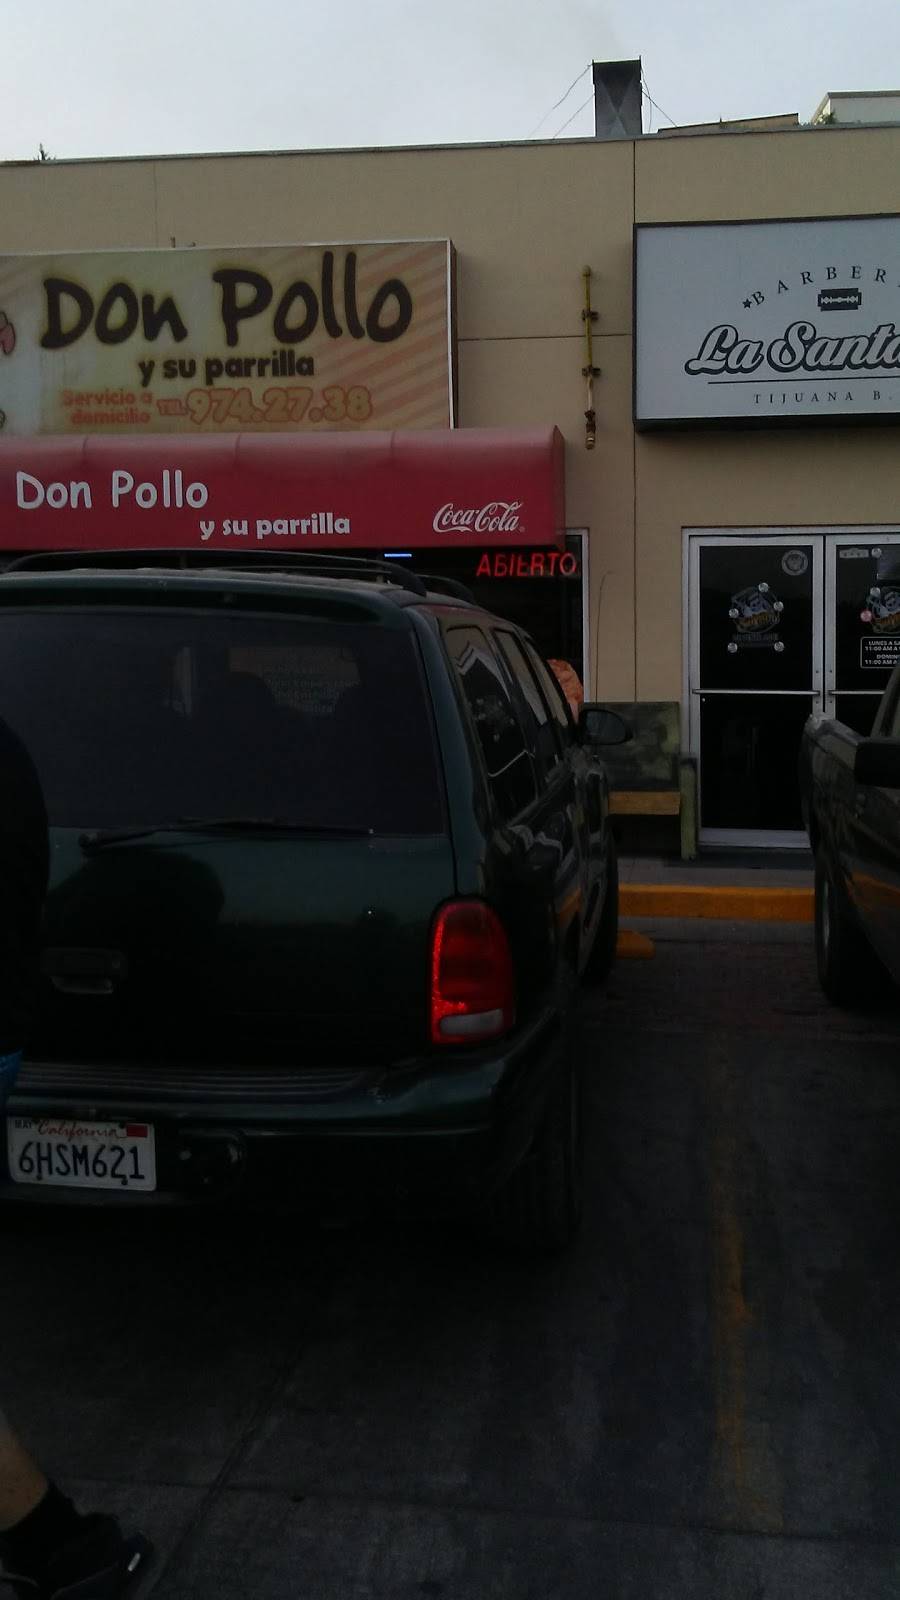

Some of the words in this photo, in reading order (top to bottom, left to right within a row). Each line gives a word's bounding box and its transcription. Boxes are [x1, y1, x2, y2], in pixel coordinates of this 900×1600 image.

[40, 278, 188, 349] Don
[212, 251, 413, 347] Pollo
[752, 265, 900, 305] BARBER
[684, 324, 765, 375] La
[138, 359, 155, 387] y
[163, 358, 196, 378] su
[205, 350, 315, 385] parrilla
[62, 390, 136, 407] Servicio
[143, 393, 153, 405] a
[186, 386, 373, 424] 974.27.38
[753, 392, 854, 404] TIJUANA
[71, 408, 151, 425] domicilio
[16, 471, 92, 509] Don
[112, 469, 208, 509] Pollo
[200, 521, 215, 540] y
[222, 520, 249, 535] su
[256, 512, 351, 540] parrilla
[433, 501, 523, 533] Coca-Cola
[474, 552, 577, 576] ABIERTO
[14, 1119, 33, 1130] MAY
[37, 1119, 128, 1142] California
[18, 1141, 145, 1180] 6HSM621
